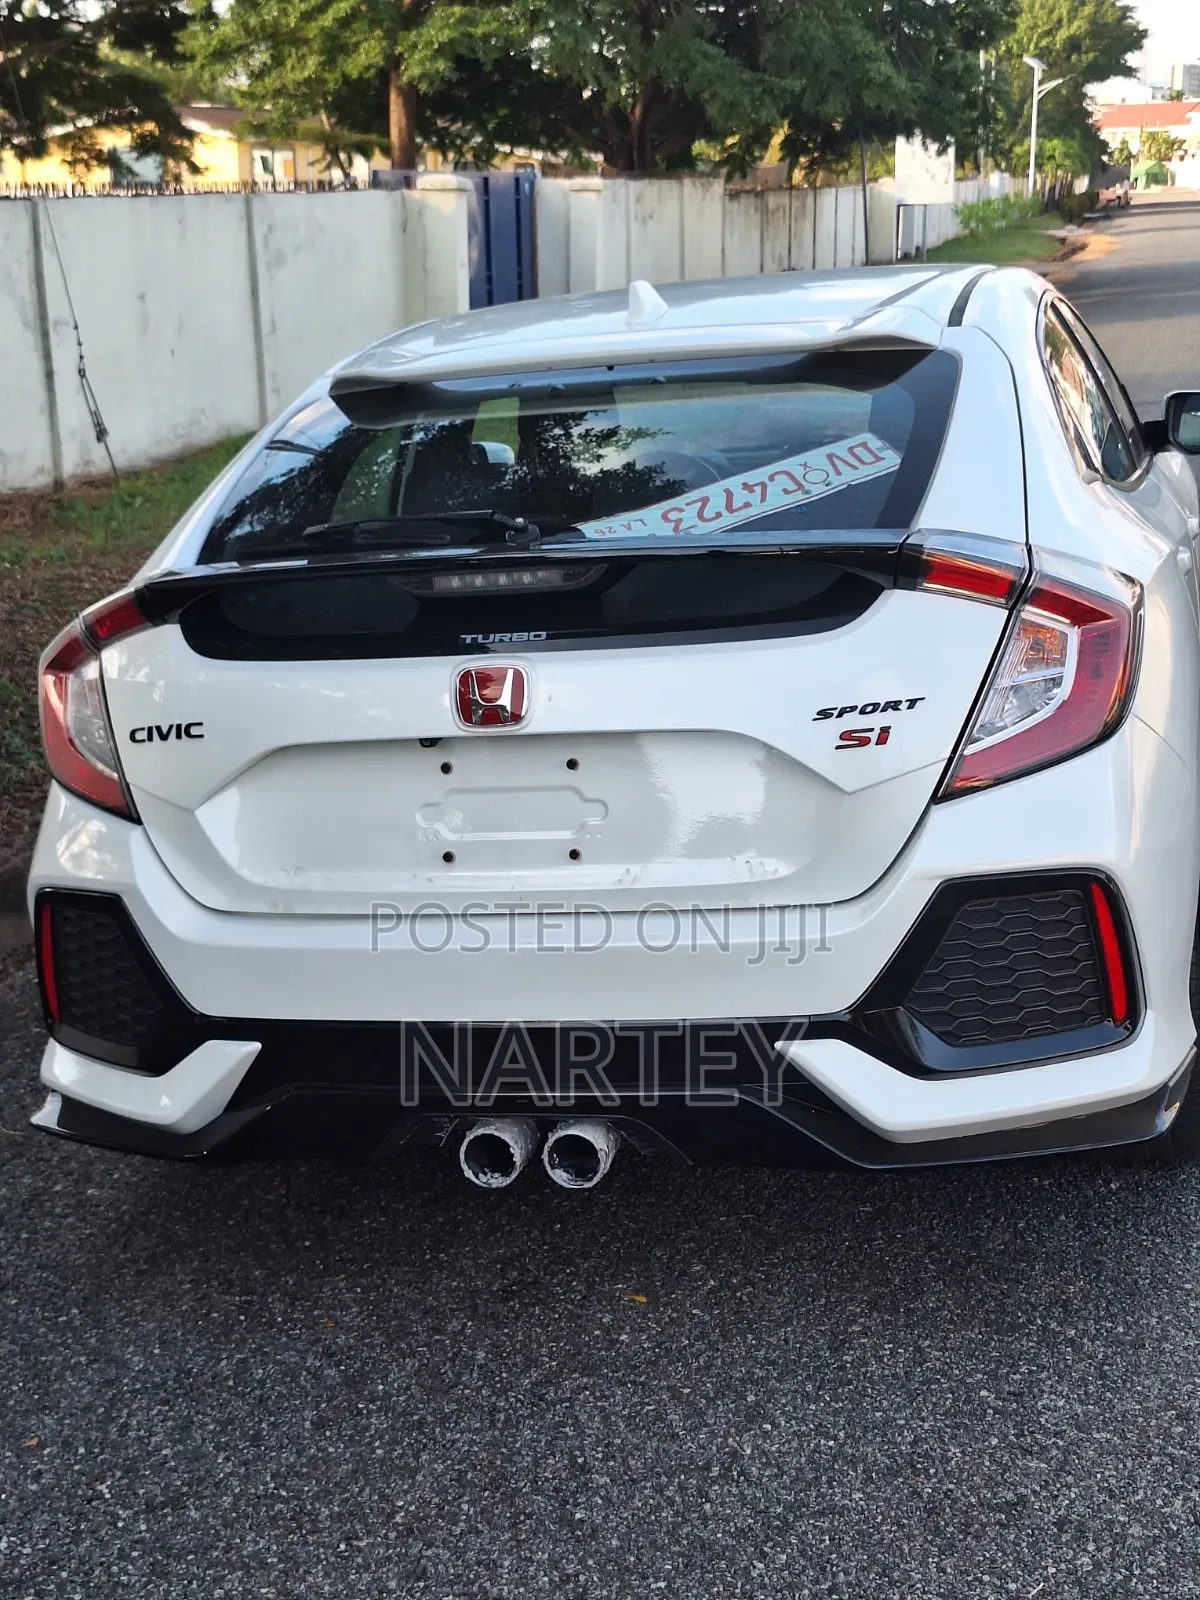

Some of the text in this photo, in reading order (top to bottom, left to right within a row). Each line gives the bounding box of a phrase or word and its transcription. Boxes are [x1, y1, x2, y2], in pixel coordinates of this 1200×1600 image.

[825, 441, 886, 477] DV
[660, 470, 806, 535] C4723
[460, 631, 547, 644] TURBO
[811, 697, 926, 722] SPORT
[129, 722, 204, 744] CIVIC
[834, 725, 892, 750] Si
